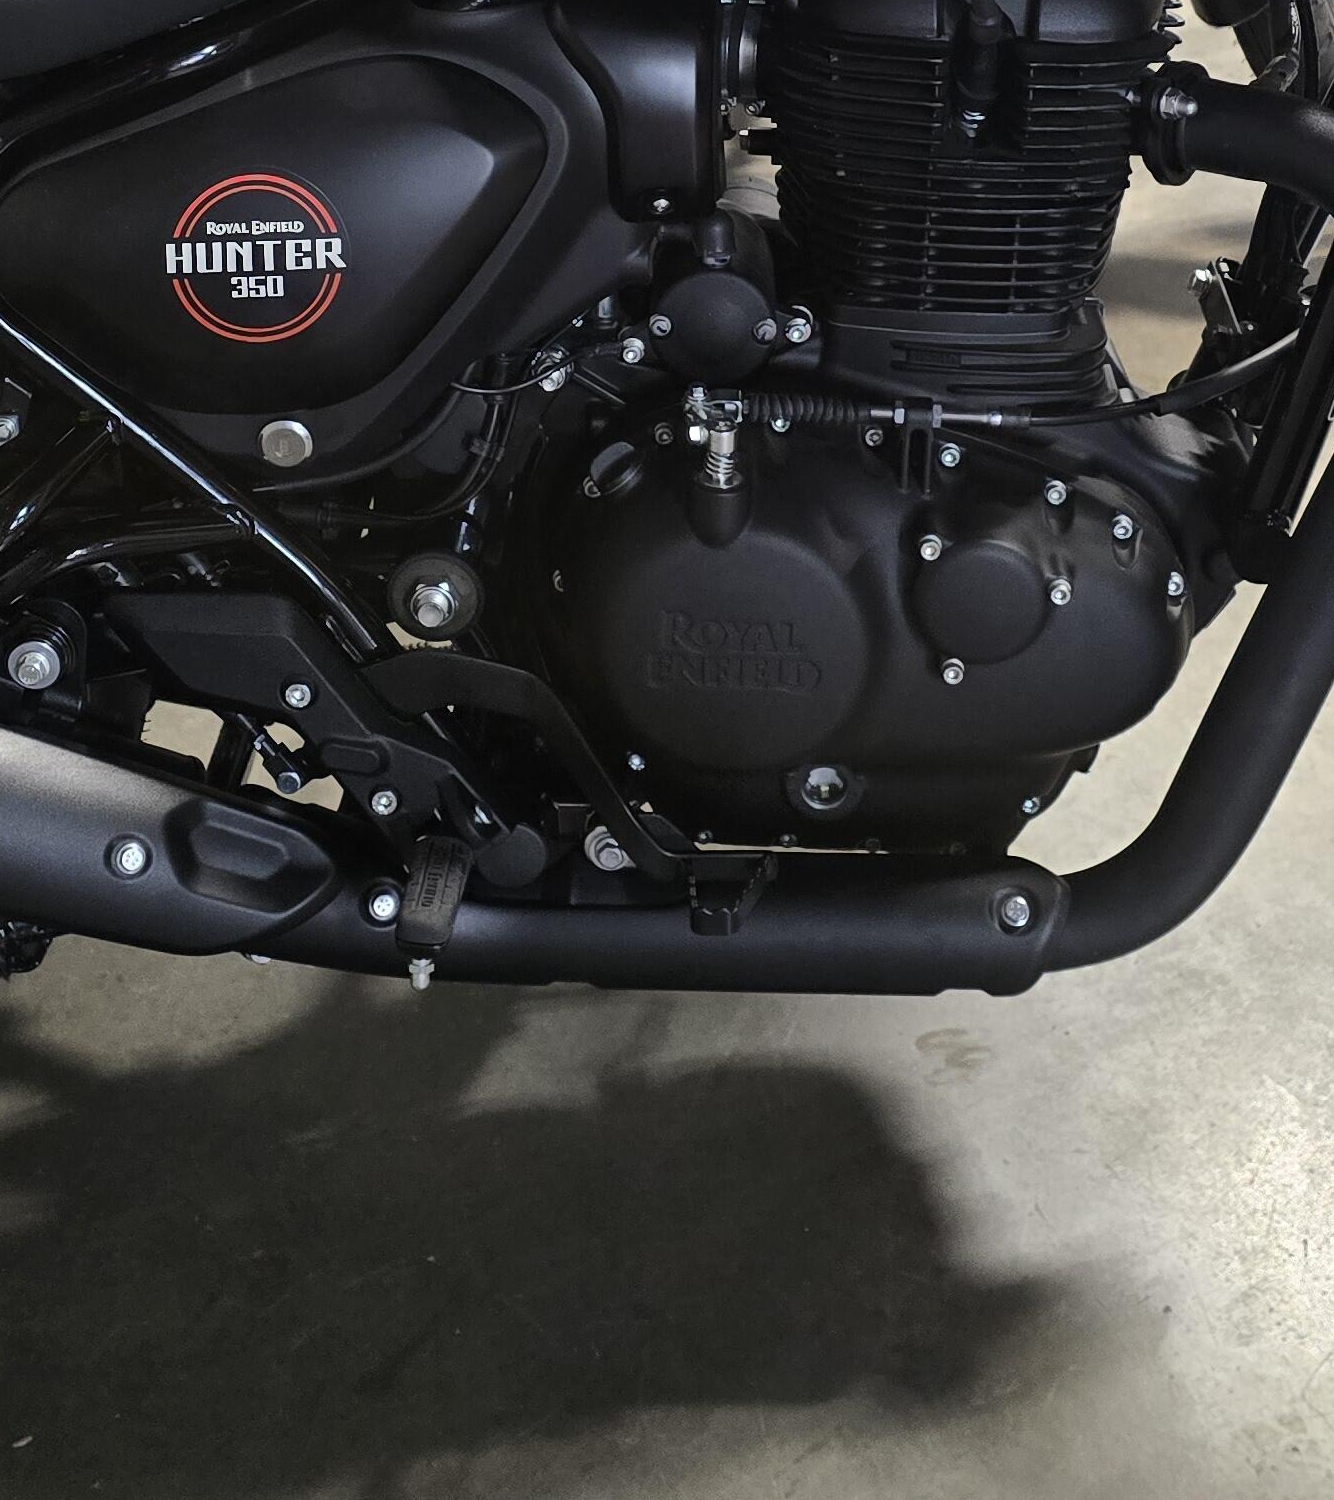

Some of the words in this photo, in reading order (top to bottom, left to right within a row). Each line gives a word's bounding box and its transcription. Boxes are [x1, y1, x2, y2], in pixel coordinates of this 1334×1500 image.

[206, 221, 249, 236] ROYAL
[251, 220, 305, 236] ENFIELD
[165, 237, 347, 274] HUNTER
[230, 275, 285, 298] 350
[661, 609, 805, 656] ROYAL
[642, 650, 823, 693] ENFIELD
